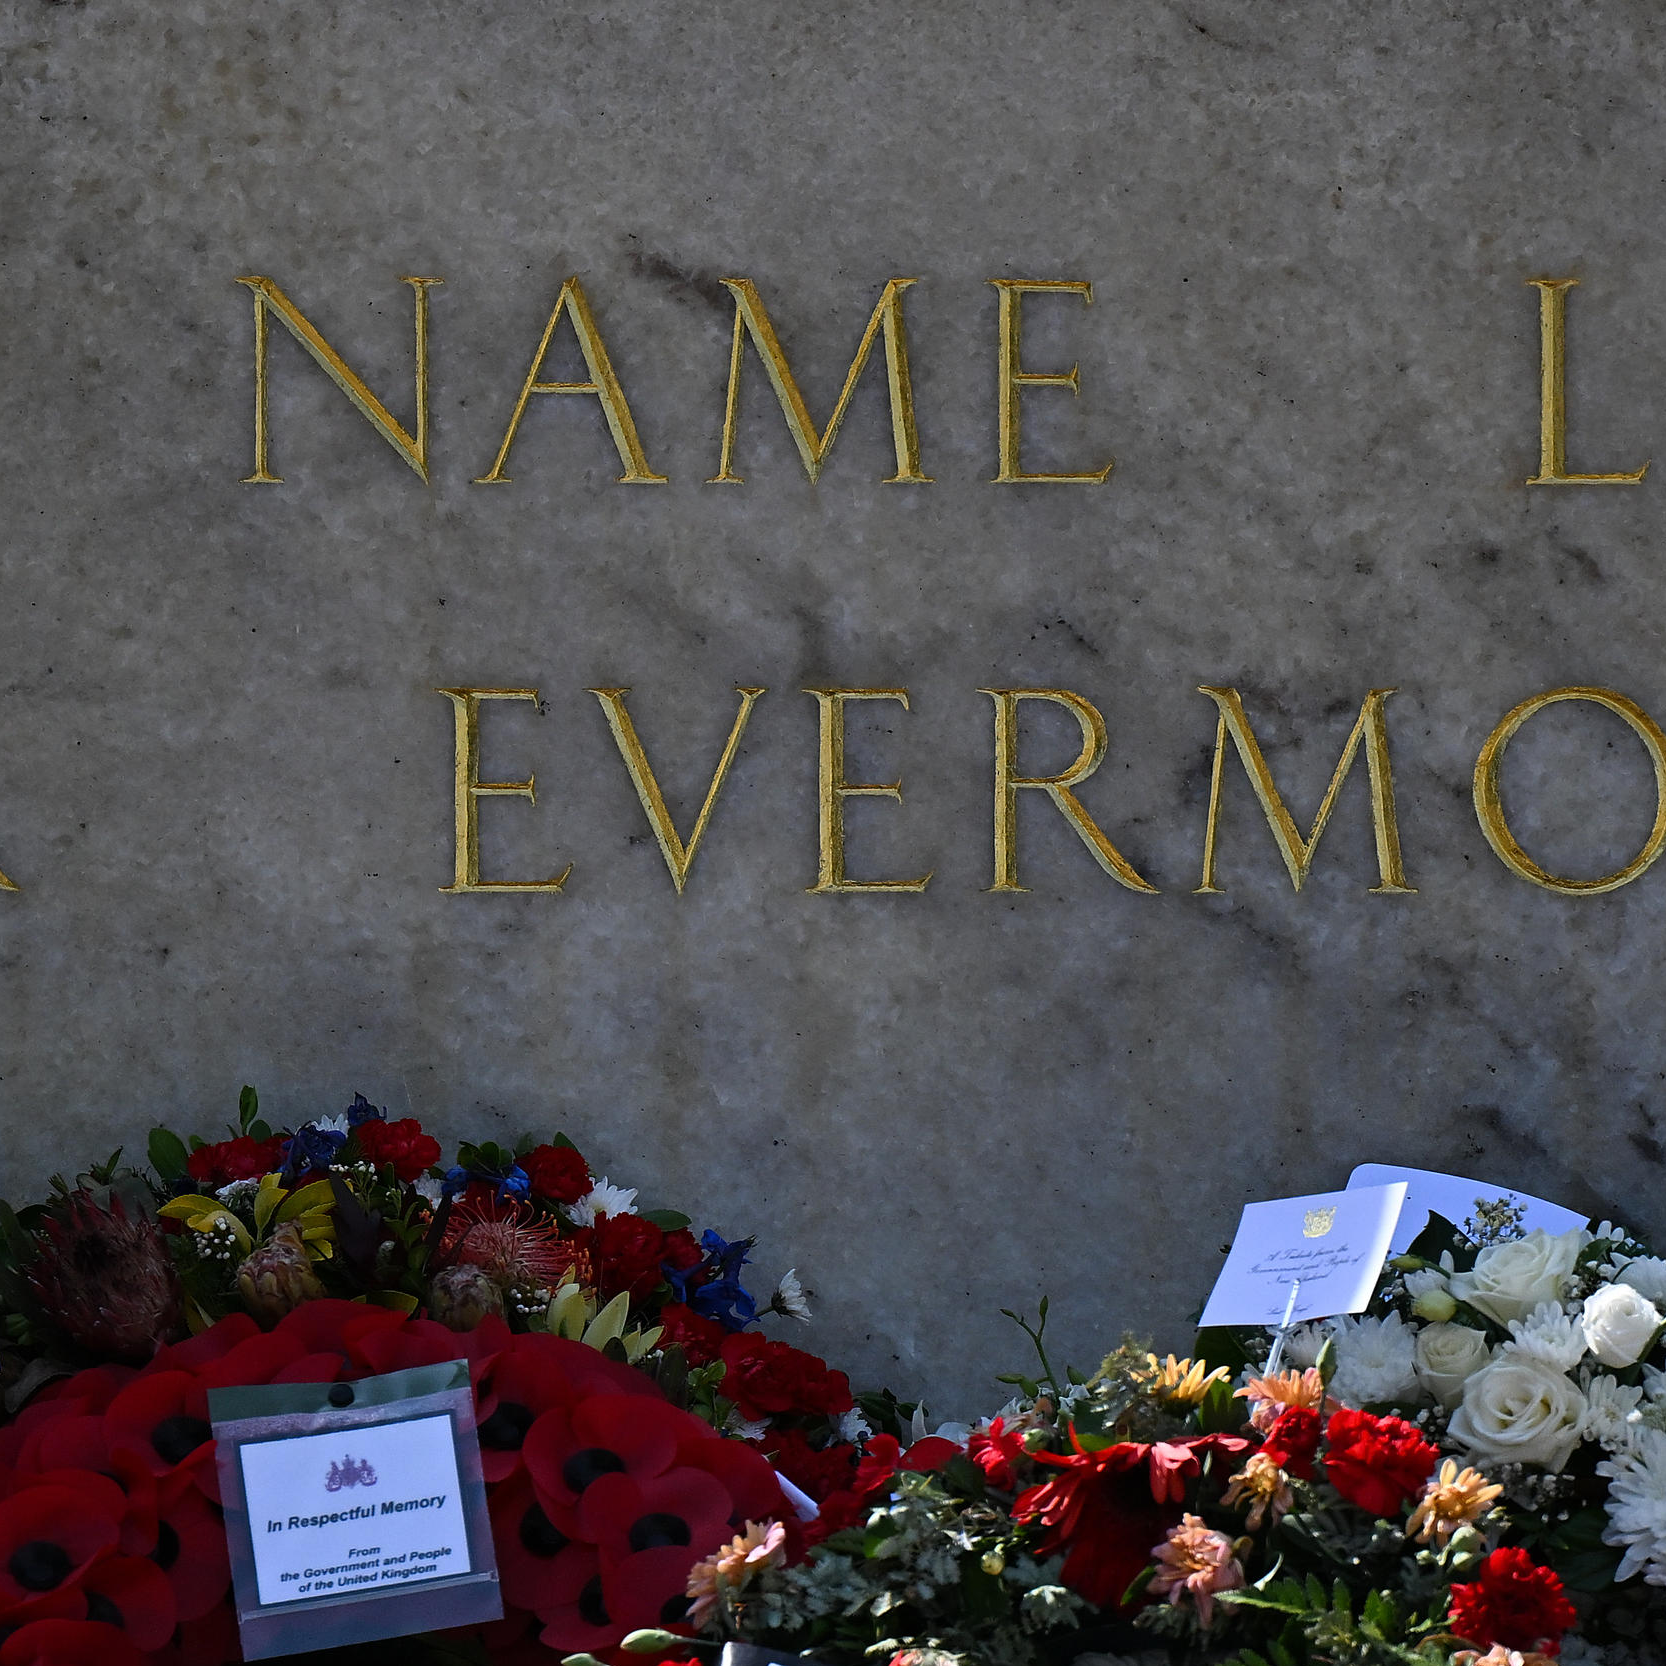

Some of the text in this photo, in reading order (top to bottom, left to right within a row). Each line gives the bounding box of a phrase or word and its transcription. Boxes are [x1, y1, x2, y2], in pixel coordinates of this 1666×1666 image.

[237, 276, 1112, 482] NAME
[267, 1493, 447, 1533] In Respectful Memory
[280, 1546, 452, 1583] the Government and People
[347, 1545, 381, 1559] From
[298, 1562, 437, 1593] of the United Kingdom
